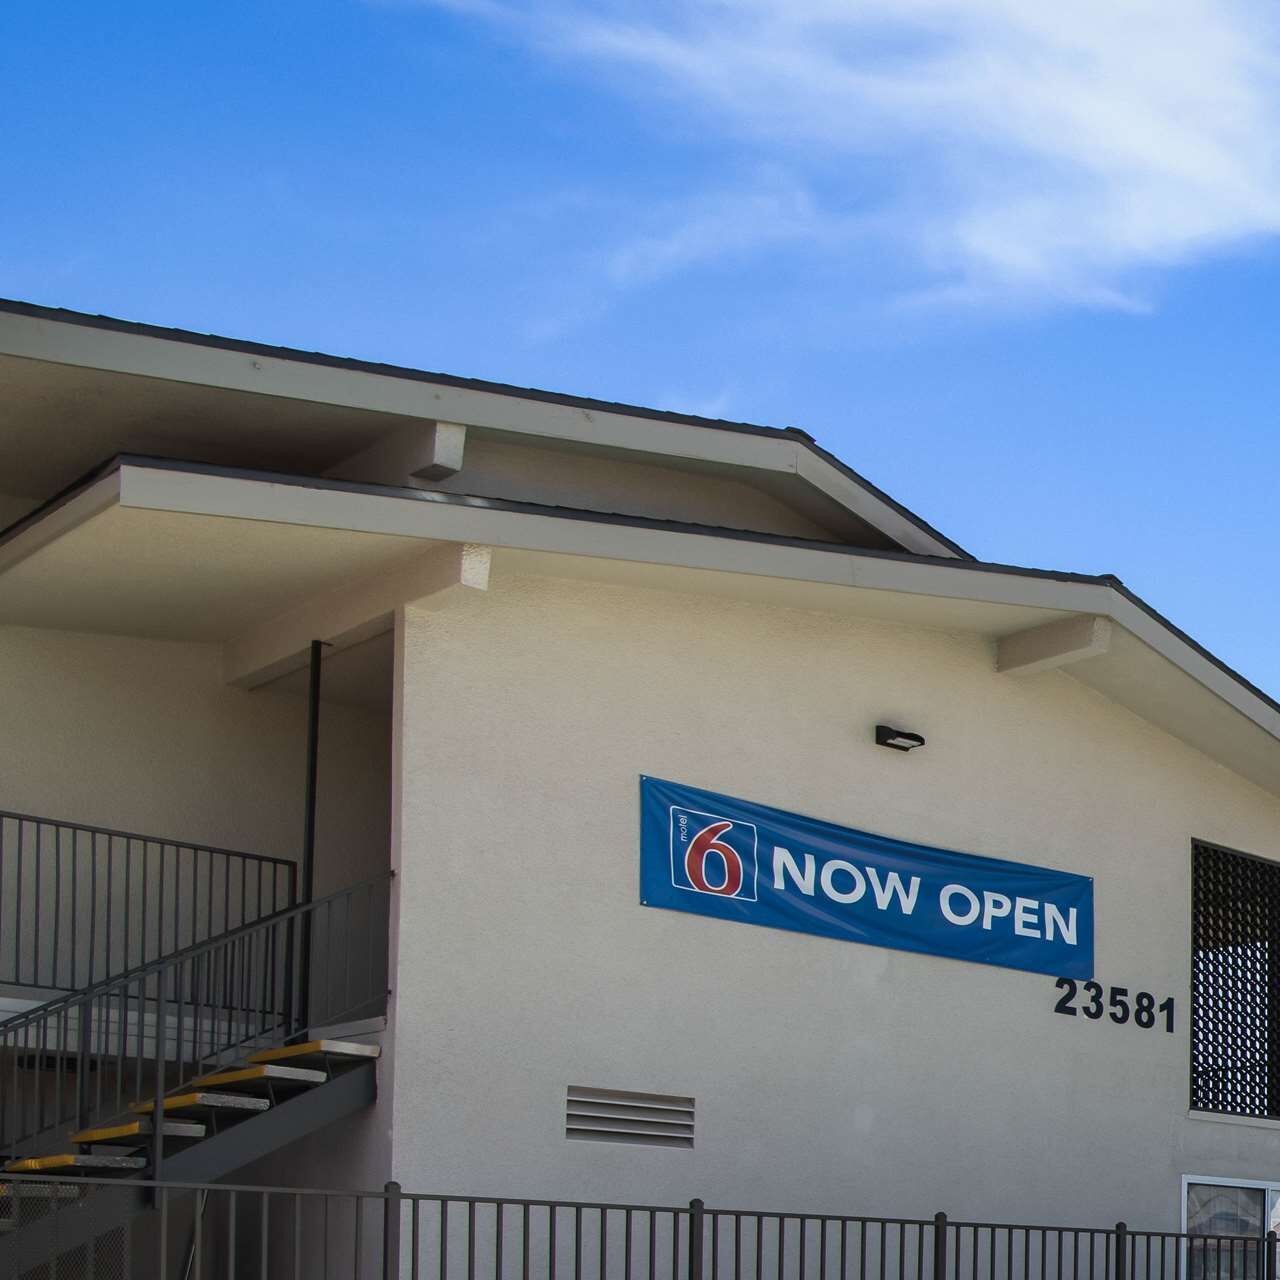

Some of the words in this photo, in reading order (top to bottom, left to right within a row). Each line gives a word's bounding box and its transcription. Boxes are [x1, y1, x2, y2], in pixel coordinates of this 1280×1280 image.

[678, 814, 688, 842] motel
[684, 821, 744, 897] 6
[773, 846, 921, 915] NOW
[939, 883, 1078, 946] OPEN
[1054, 977, 1175, 1033] 23581
